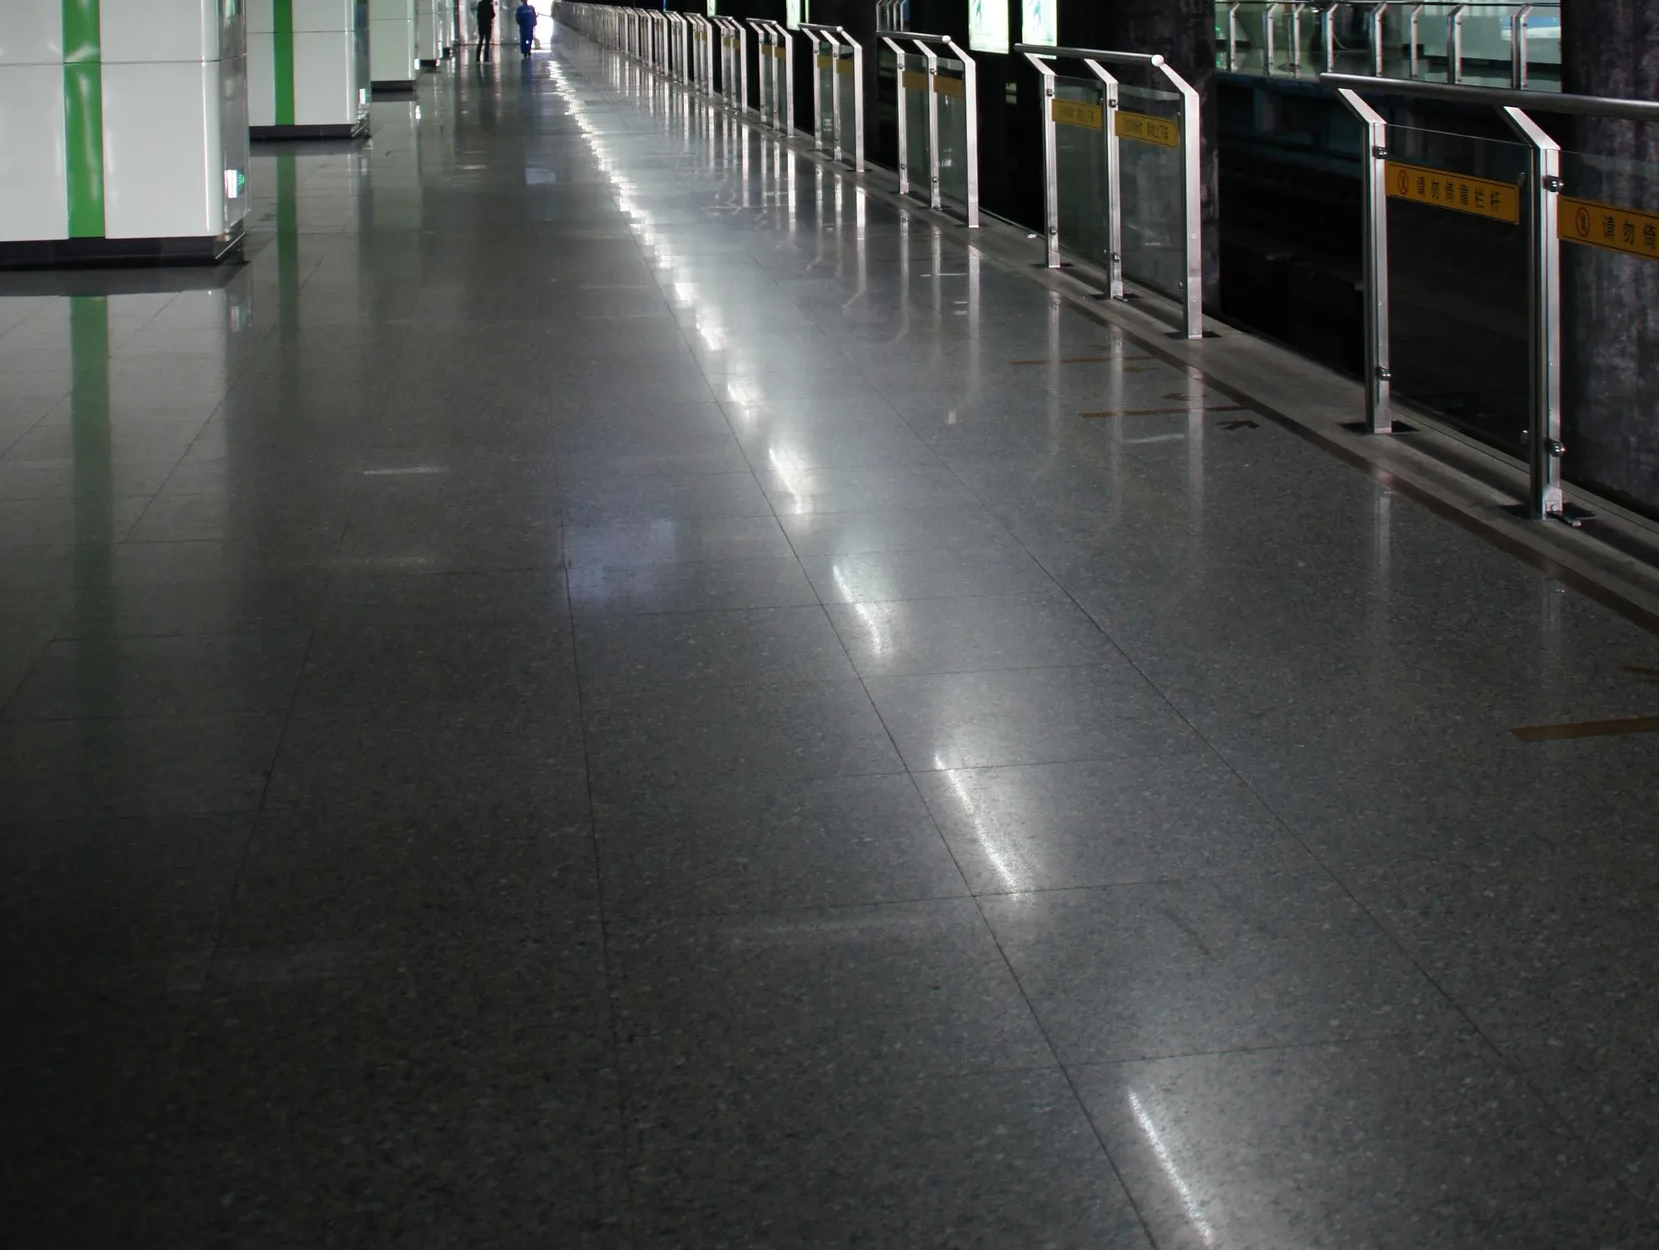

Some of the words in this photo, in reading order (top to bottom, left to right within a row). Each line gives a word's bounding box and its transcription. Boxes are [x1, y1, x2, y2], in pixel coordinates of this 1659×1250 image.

[1415, 175, 1501, 212] 请勿倚靠栏杆
[1602, 214, 1657, 250] 请勿倚
